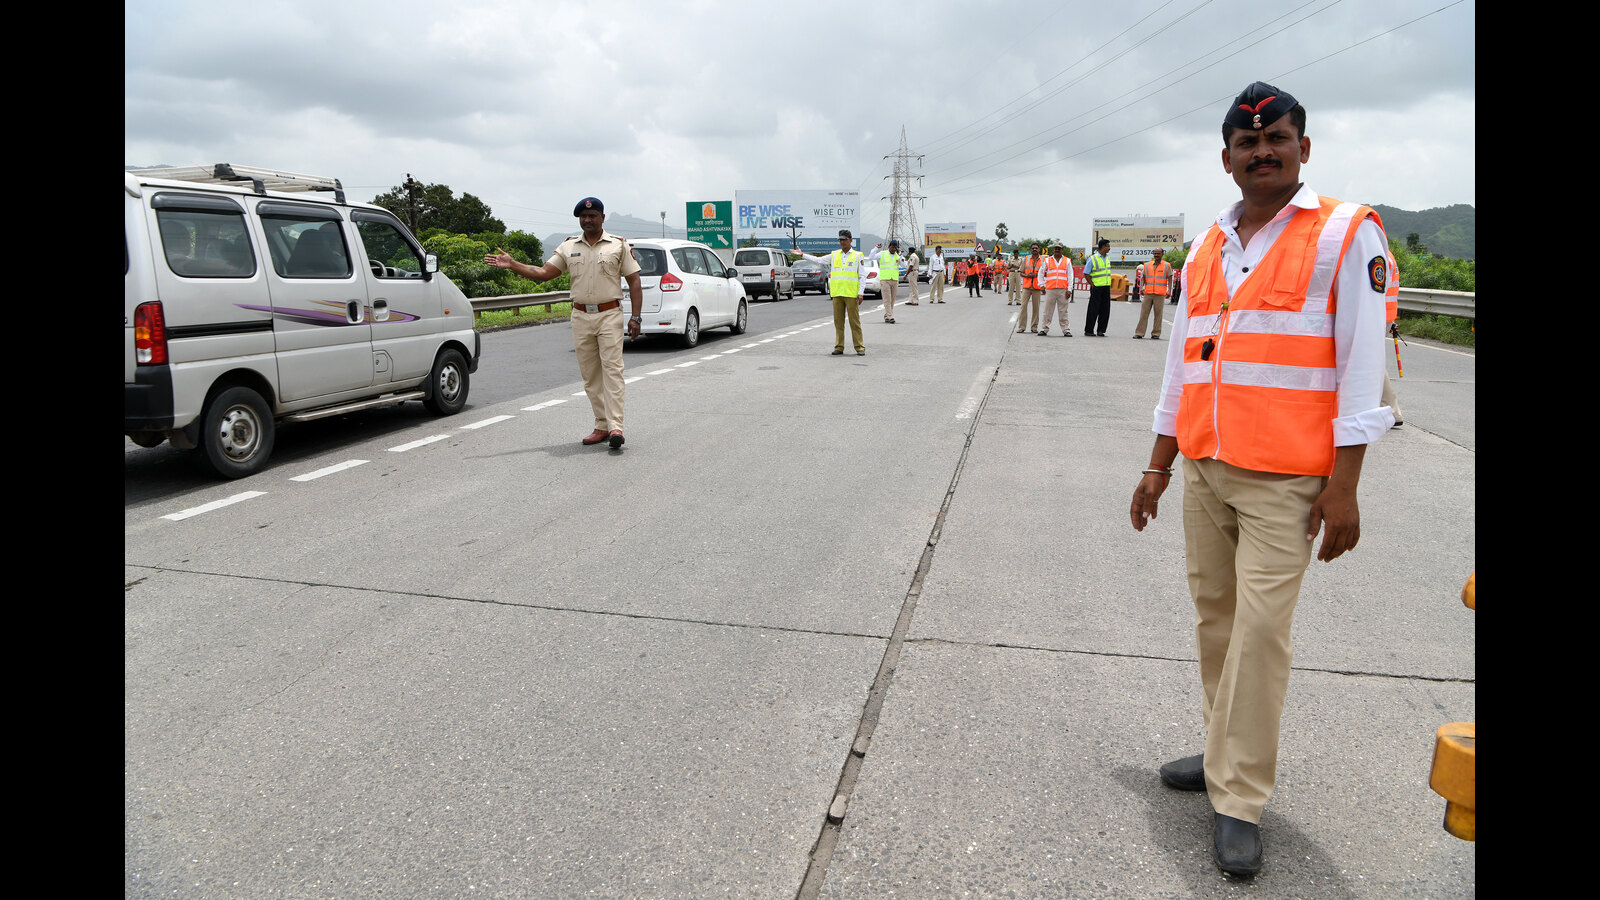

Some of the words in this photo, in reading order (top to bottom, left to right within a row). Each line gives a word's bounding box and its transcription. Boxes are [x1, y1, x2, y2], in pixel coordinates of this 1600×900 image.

[738, 205, 757, 217] BE
[813, 208, 834, 216] WISE
[837, 208, 855, 216] CITY
[739, 216, 768, 229] LIVE
[771, 216, 806, 229] WISE.
